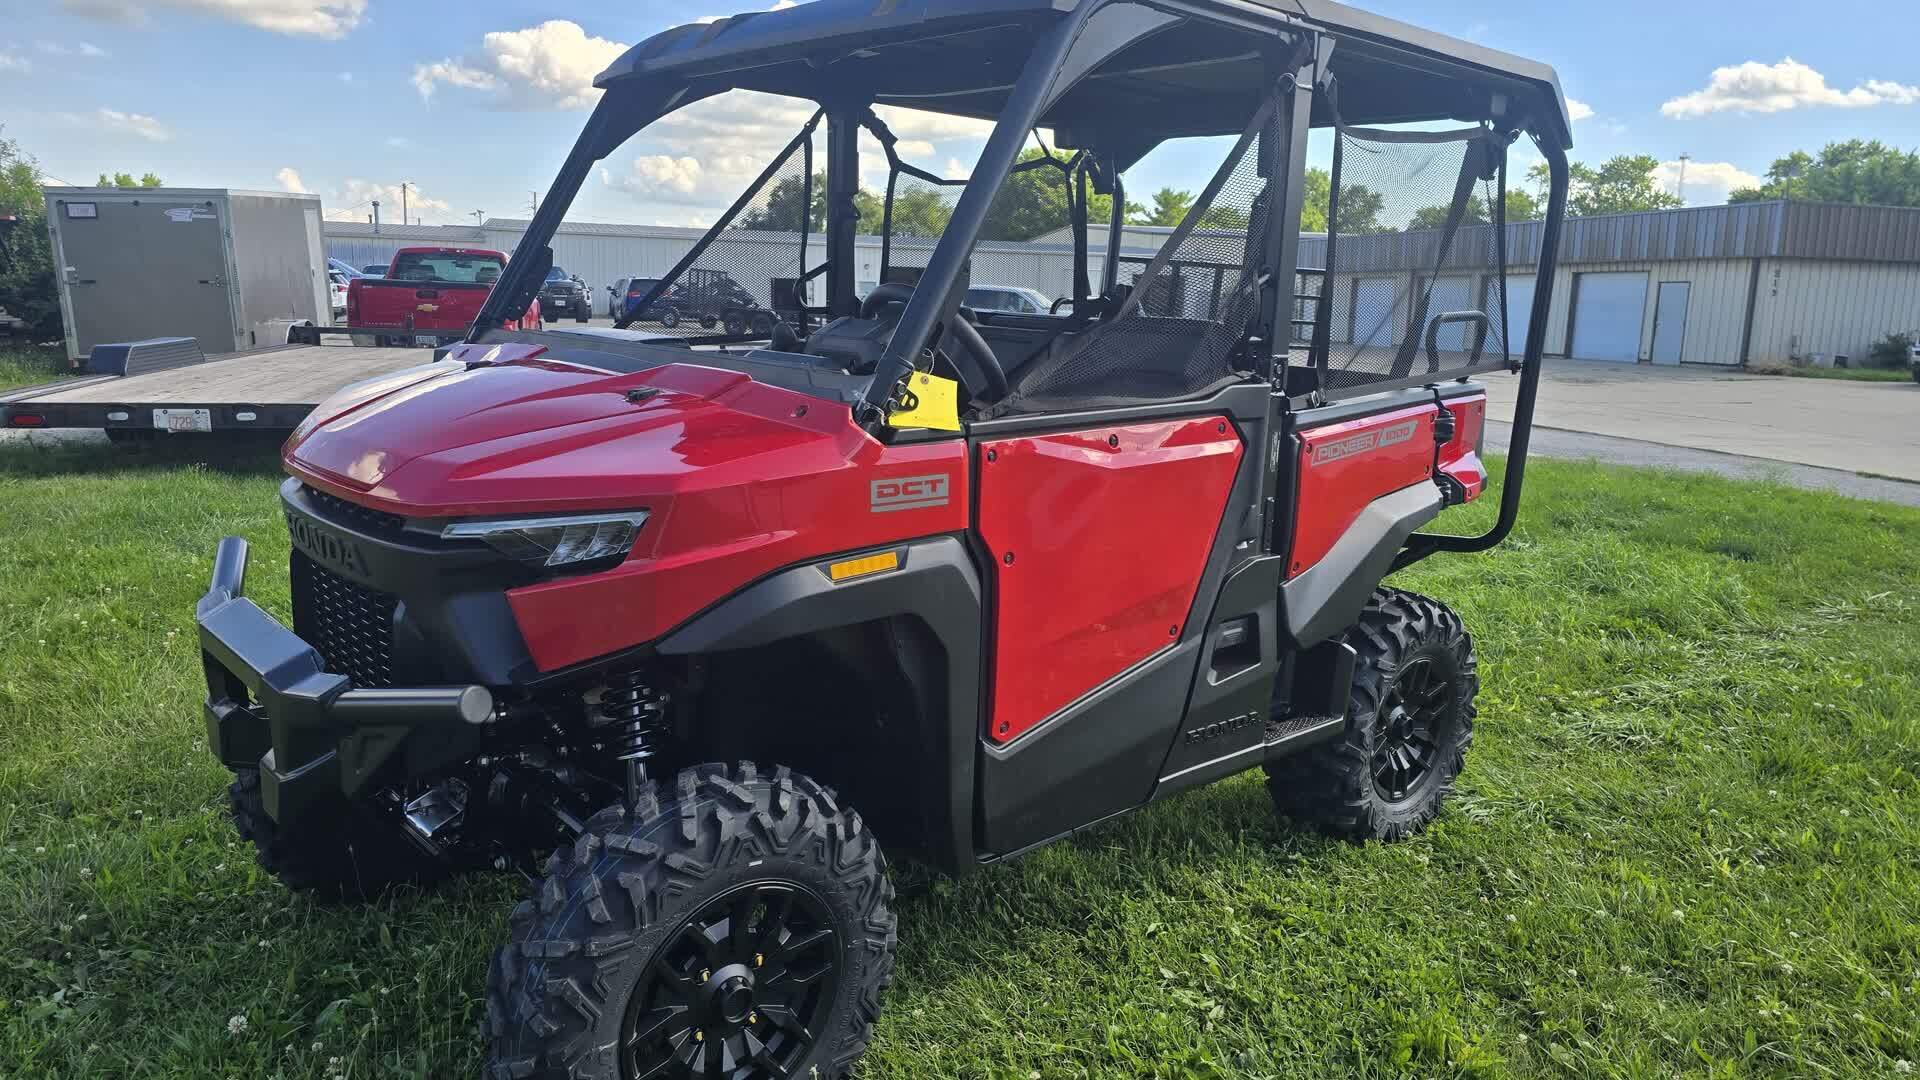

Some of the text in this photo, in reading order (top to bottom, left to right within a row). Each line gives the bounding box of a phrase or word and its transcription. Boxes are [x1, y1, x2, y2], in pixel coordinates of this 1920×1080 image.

[1318, 433, 1375, 459] PIONEER
[876, 479, 945, 499] DCT
[1185, 711, 1261, 745] HONDA
